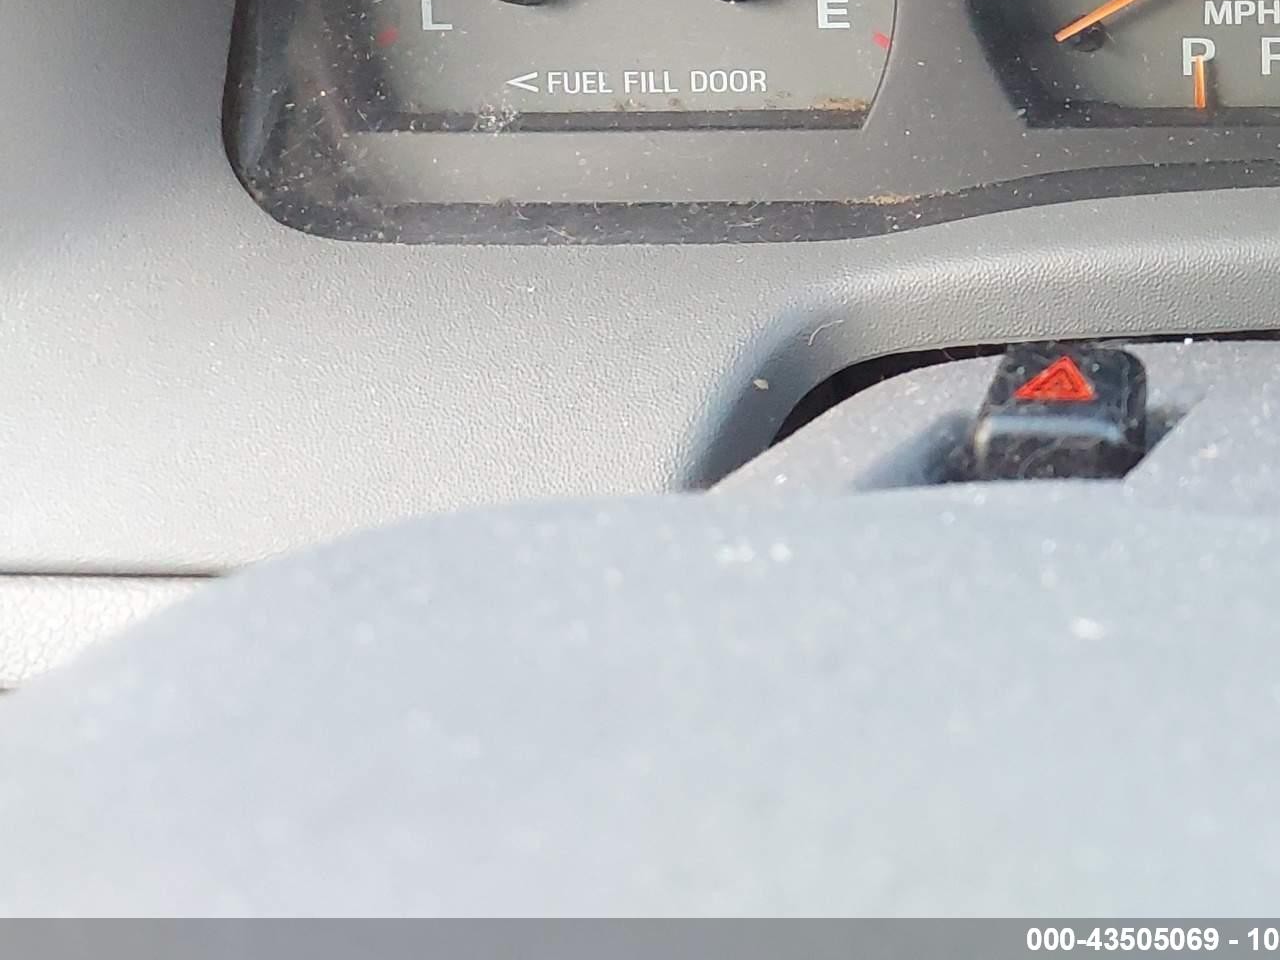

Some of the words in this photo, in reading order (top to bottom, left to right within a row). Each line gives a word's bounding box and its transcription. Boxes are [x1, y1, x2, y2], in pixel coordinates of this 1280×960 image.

[421, 0, 453, 31] L
[1204, 0, 1280, 24] MPH
[1182, 37, 1214, 75] P
[547, 72, 612, 93] FUEL
[624, 71, 678, 93] FILL
[690, 71, 768, 93] DOOR
